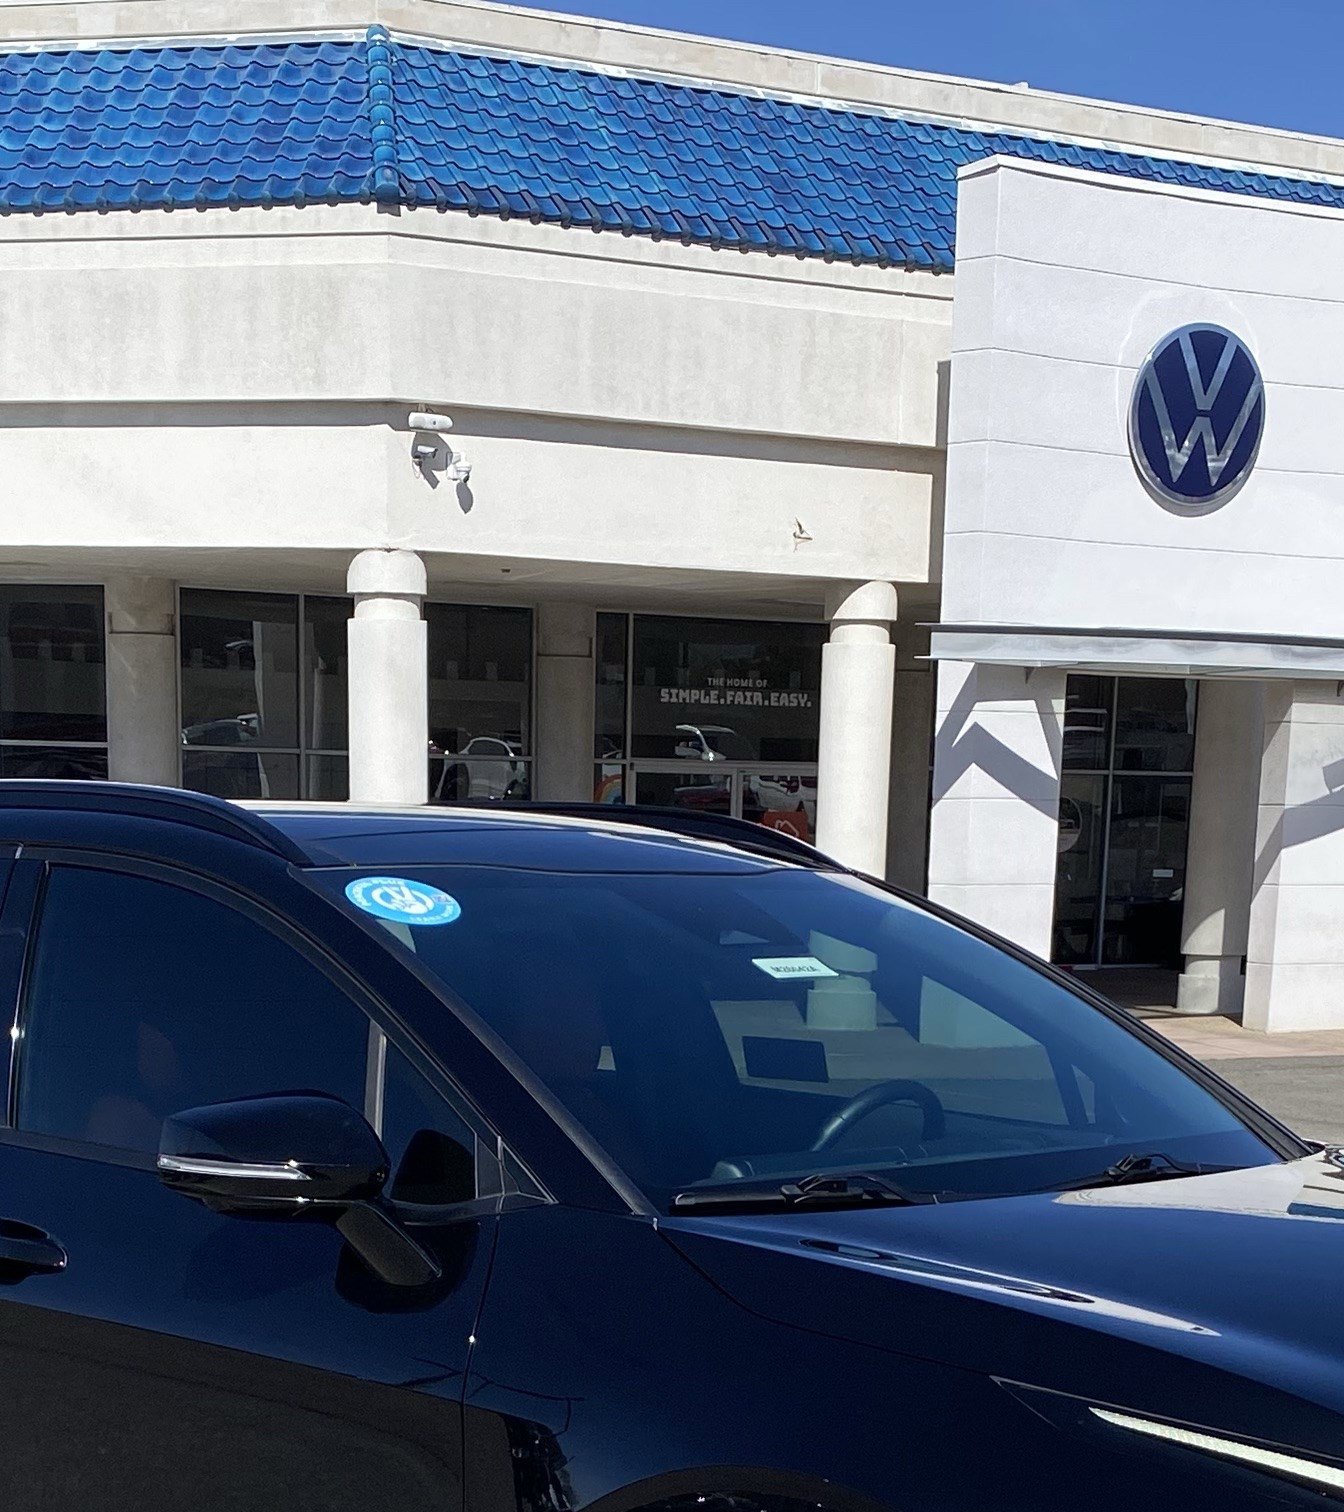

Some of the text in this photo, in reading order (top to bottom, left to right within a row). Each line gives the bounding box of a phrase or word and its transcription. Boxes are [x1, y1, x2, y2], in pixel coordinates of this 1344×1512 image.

[707, 677, 768, 688] THE HOME OF
